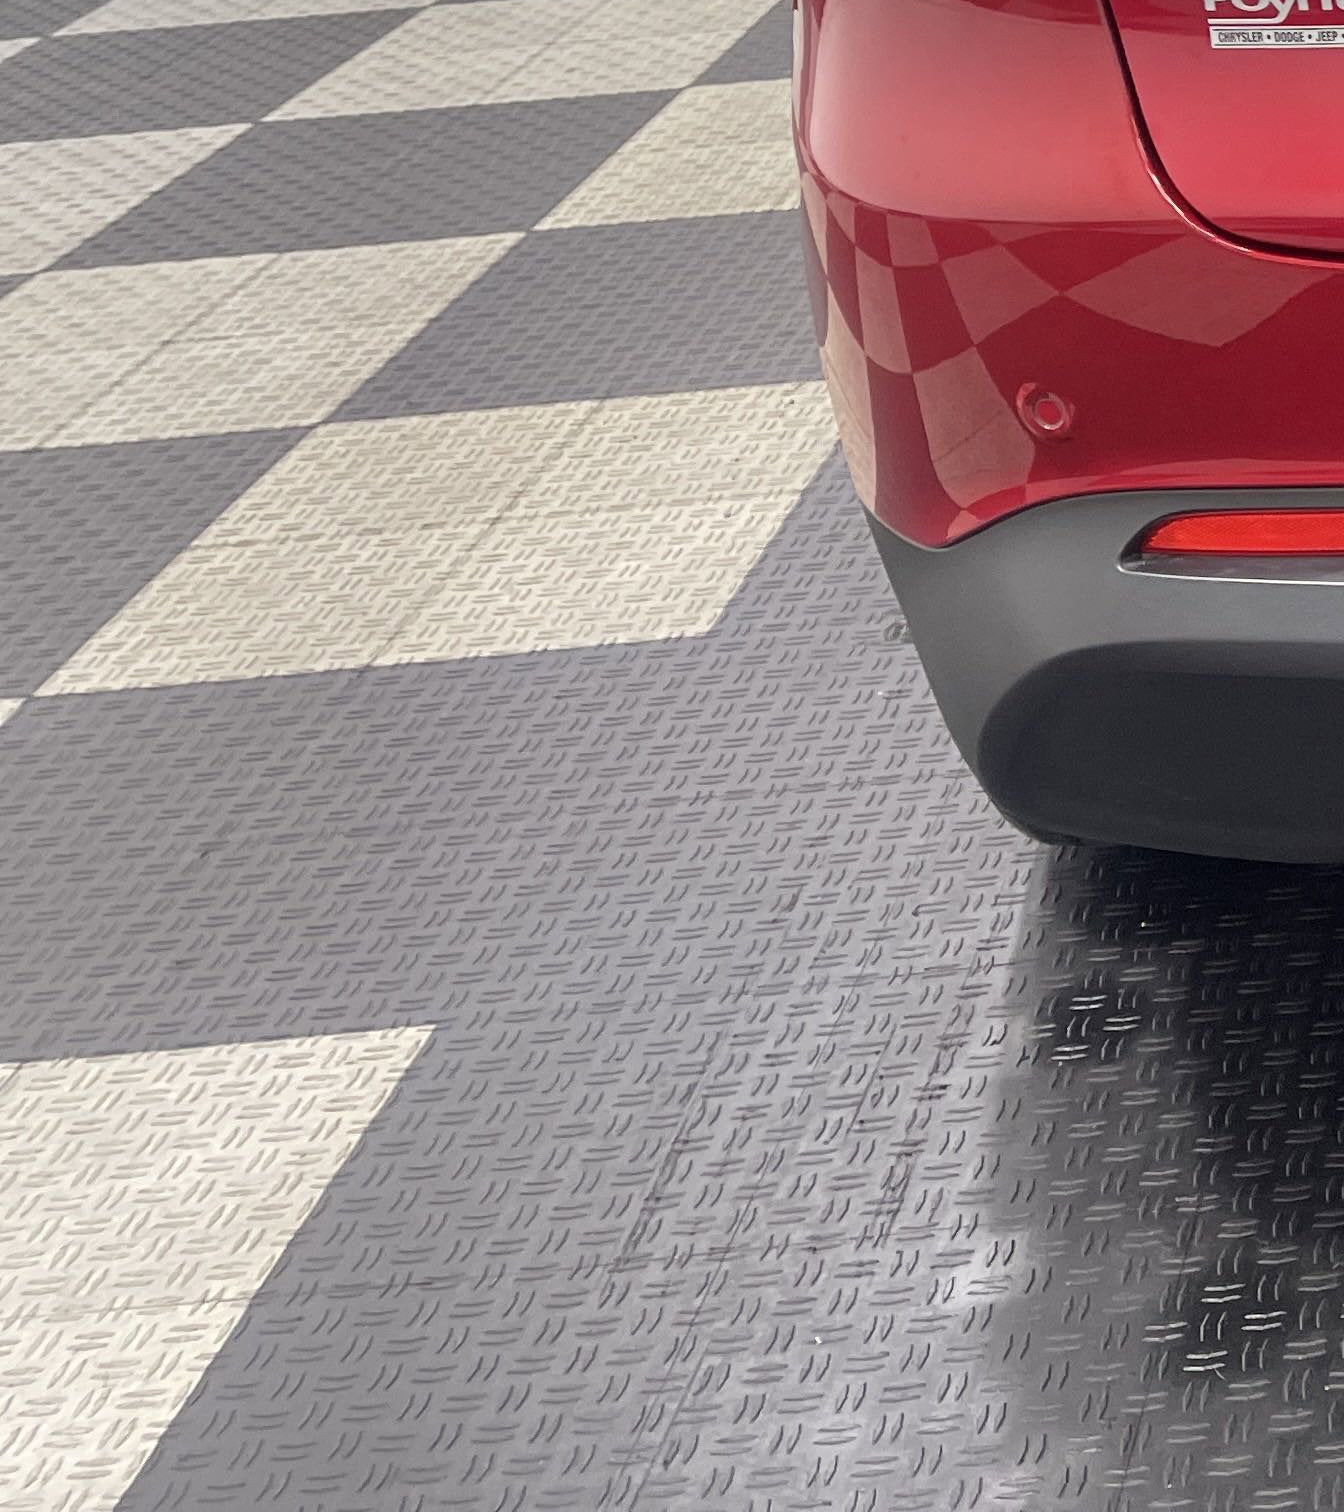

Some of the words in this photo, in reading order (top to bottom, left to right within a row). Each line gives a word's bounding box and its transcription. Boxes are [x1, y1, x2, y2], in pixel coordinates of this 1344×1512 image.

[1218, 31, 1263, 43] CHRYSLER
[1274, 31, 1305, 43] DODGE
[1316, 31, 1338, 42] JEEP
